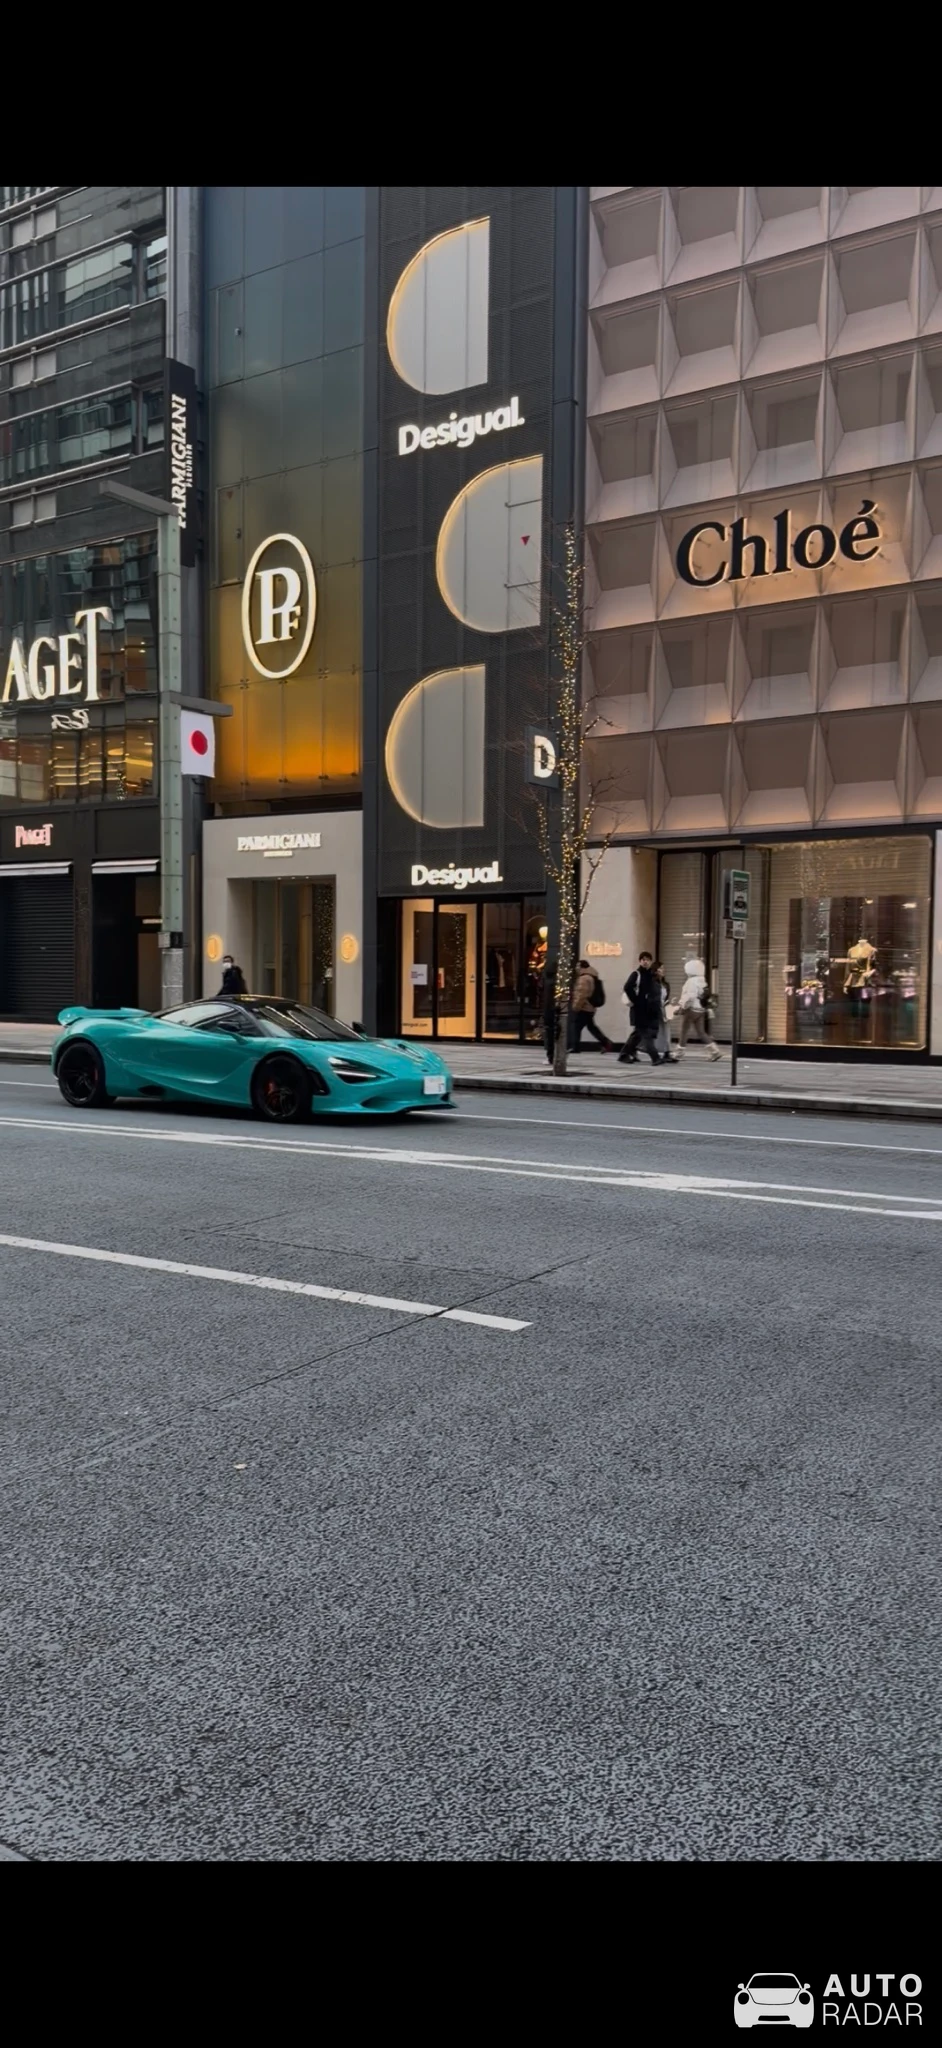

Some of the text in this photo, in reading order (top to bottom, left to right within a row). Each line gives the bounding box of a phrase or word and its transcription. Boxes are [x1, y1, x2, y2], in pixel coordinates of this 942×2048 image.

[398, 396, 525, 456] Desigual.
[676, 500, 883, 588] Chloé
[534, 735, 556, 778] D
[237, 832, 321, 851] PARMIGIANI
[411, 860, 504, 890] Desigual.
